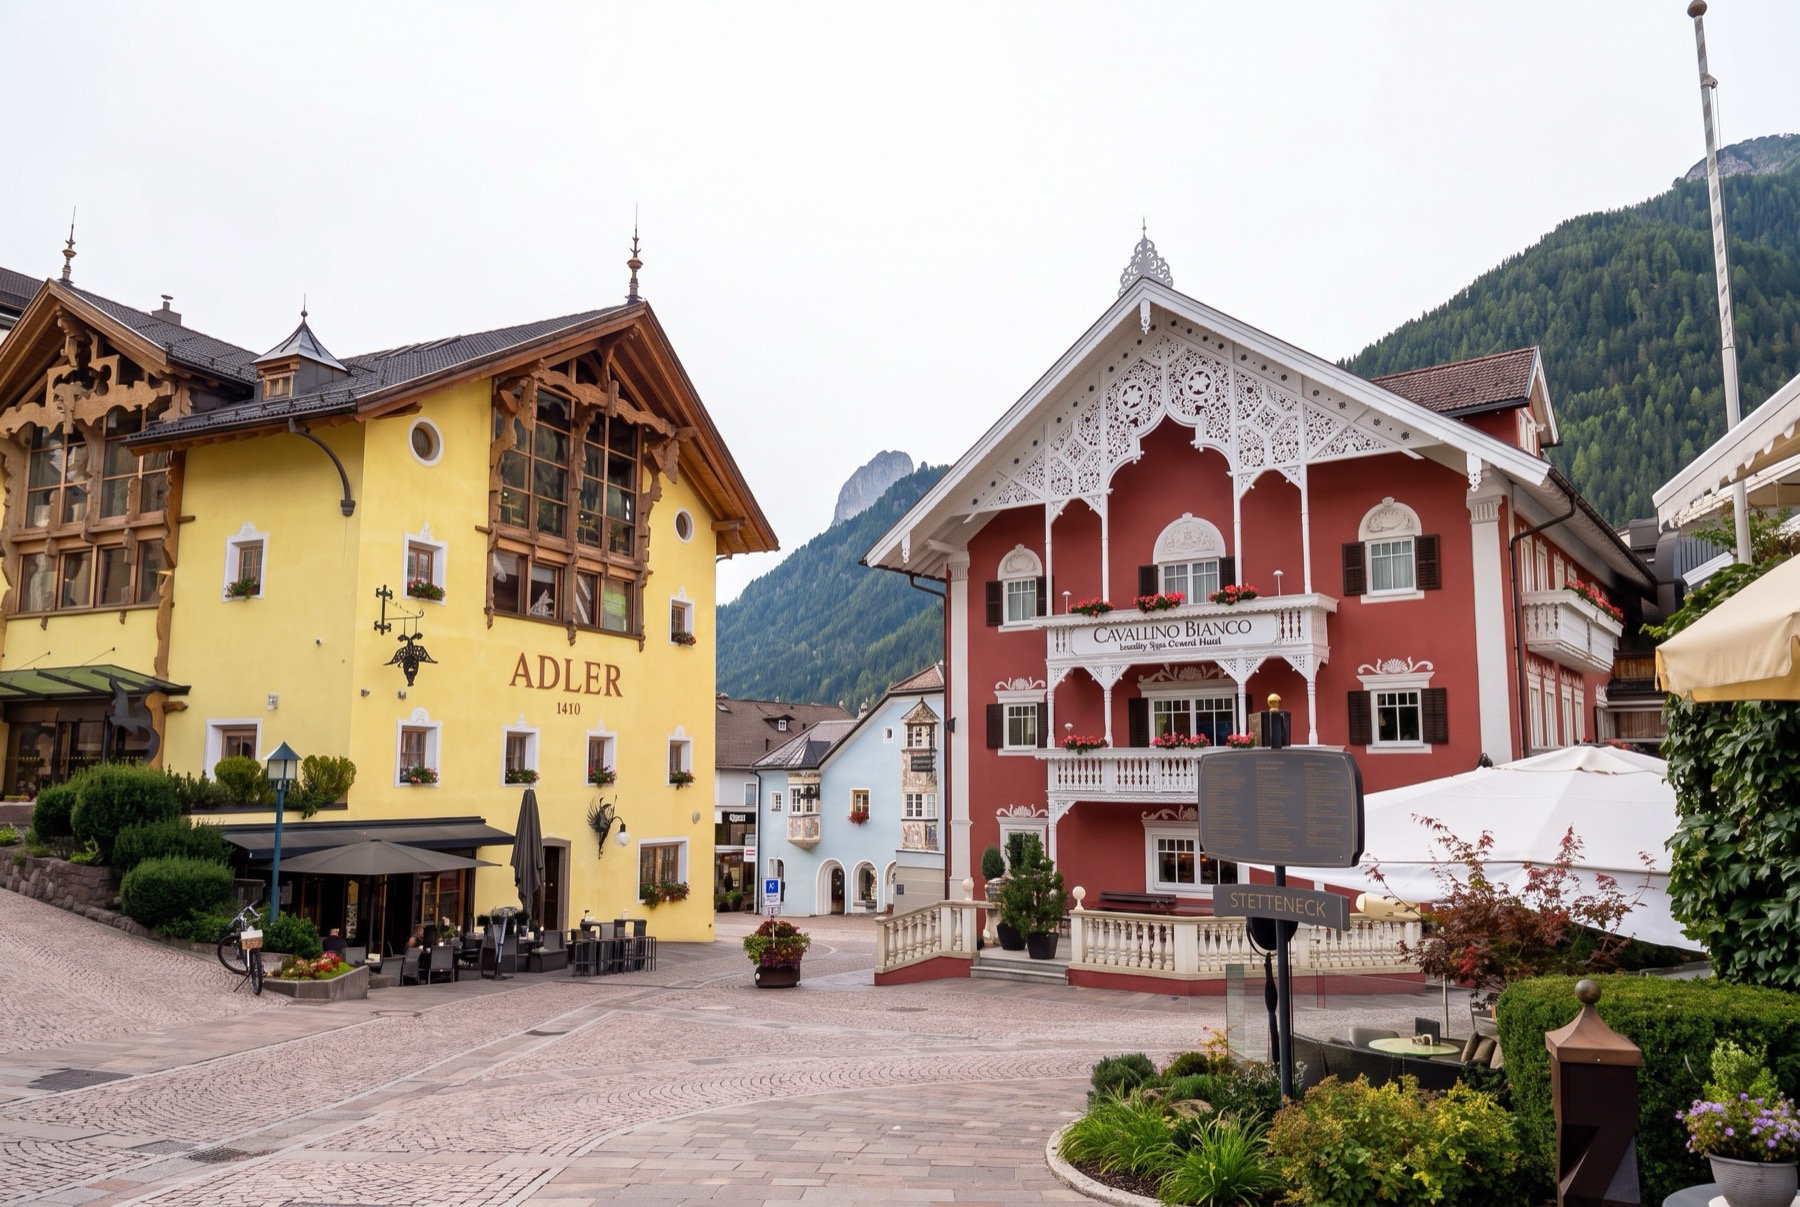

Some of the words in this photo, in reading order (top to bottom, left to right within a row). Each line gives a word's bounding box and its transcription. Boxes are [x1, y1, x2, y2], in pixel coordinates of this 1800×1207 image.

[1093, 624, 1180, 643] CAVALLINO
[1185, 619, 1252, 637] BIANCO
[508, 652, 623, 697] ADLER
[557, 702, 581, 715] 1410
[1230, 892, 1326, 918] STETTENECK
